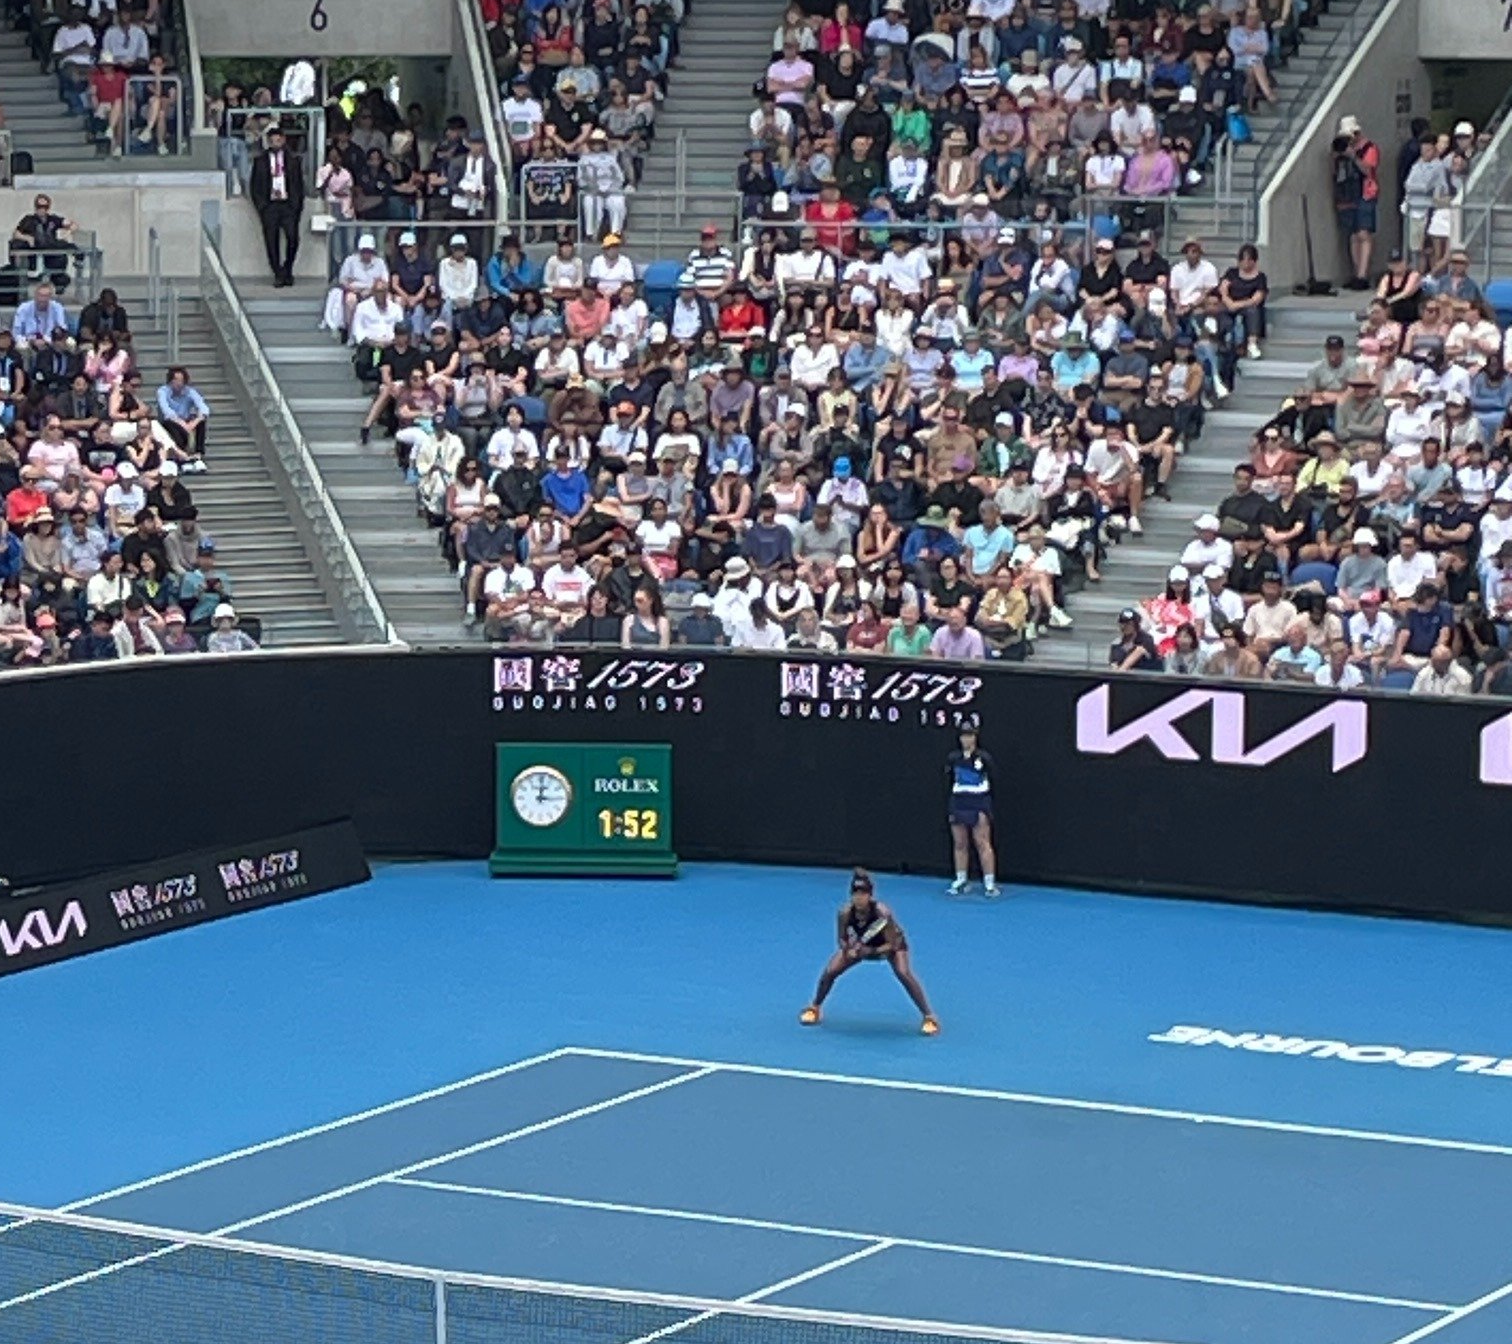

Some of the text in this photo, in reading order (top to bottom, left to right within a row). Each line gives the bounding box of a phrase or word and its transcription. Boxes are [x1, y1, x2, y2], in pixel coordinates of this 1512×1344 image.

[1076, 683, 1368, 774] KIA
[594, 778, 659, 794] ROLEX
[598, 808, 658, 841] 1:52
